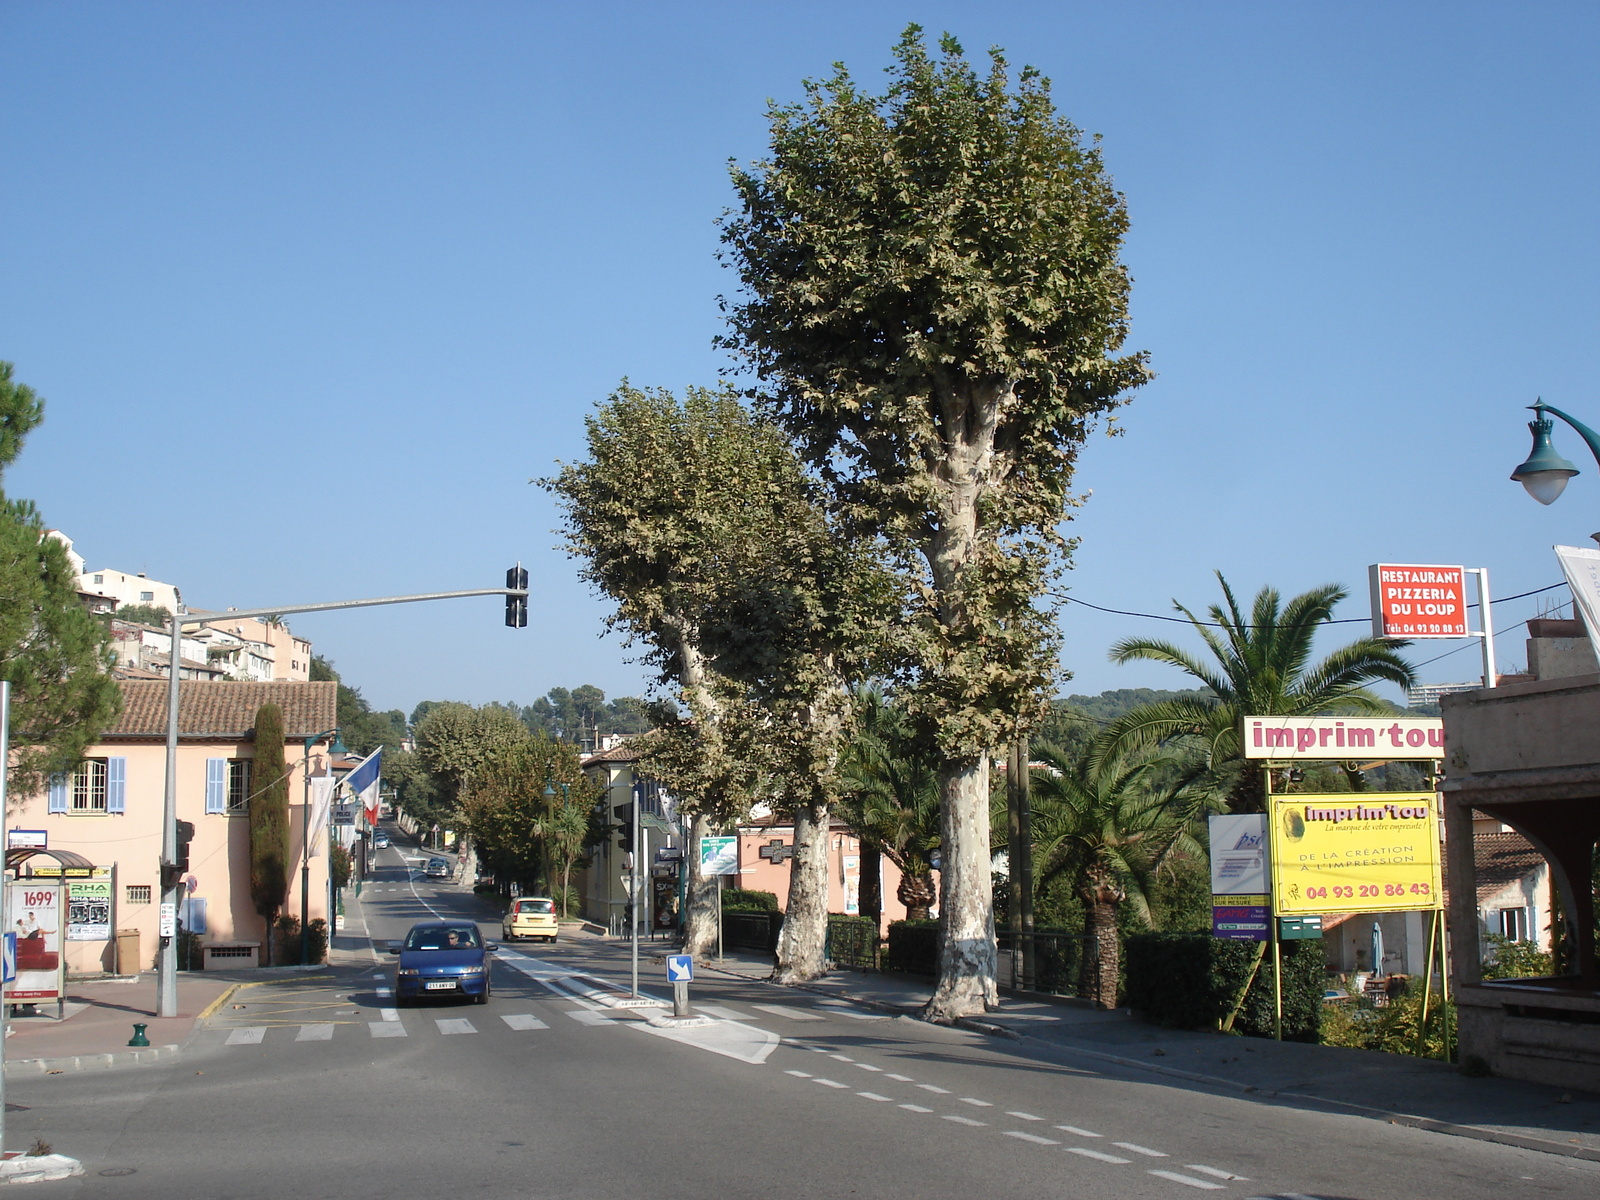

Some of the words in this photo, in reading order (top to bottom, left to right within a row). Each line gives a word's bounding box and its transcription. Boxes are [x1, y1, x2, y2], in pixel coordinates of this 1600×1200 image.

[1382, 570, 1459, 584] RESTAURANT
[1388, 588, 1457, 600] PIZZERIA
[1391, 603, 1411, 615] DU
[1417, 604, 1456, 616] LOUP
[1386, 623, 1401, 633] Tél:
[1403, 624, 1414, 633] 04
[1417, 624, 1427, 633] 93
[1429, 624, 1440, 633] 20
[1253, 721, 1444, 752] imprim'tou
[1304, 804, 1428, 824] imprim'tou
[1325, 823, 1334, 831] La
[1335, 824, 1361, 834] marque
[1362, 822, 1371, 831] de
[1372, 823, 1388, 831] votre
[1389, 822, 1423, 833] empreinte
[1345, 845, 1413, 857] CRÉATION
[1317, 855, 1414, 870] L'IMPRESSION
[1306, 887, 1327, 899] 04
[1332, 885, 1354, 898] 93
[1358, 884, 1379, 897] 20
[1384, 884, 1405, 896] 86
[1409, 883, 1430, 895] 43
